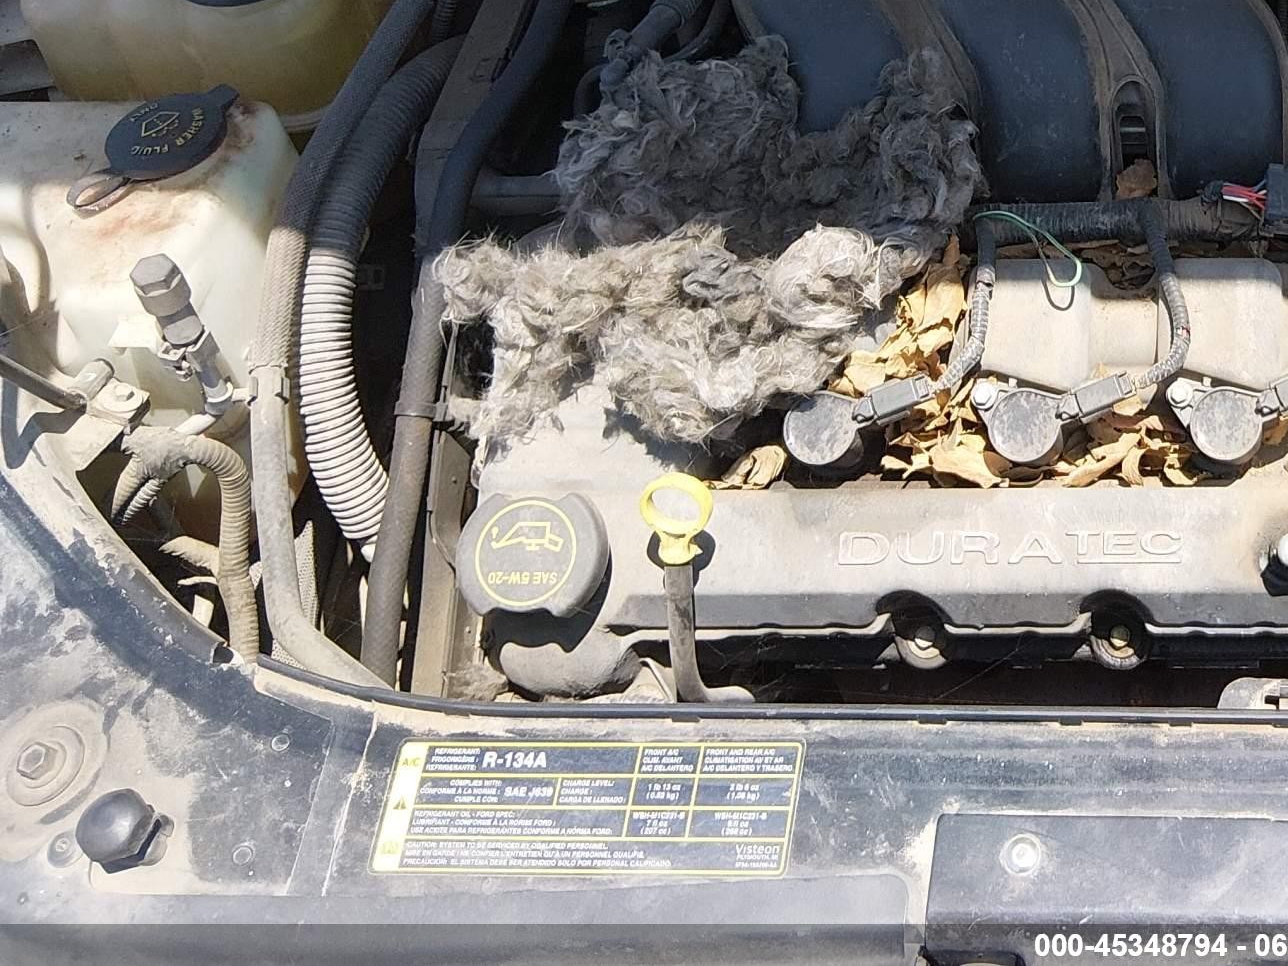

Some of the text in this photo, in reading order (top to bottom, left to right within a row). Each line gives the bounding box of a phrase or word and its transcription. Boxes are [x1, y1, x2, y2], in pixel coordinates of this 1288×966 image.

[130, 103, 159, 123] ONLY
[175, 107, 204, 146] WASHER
[838, 530, 1184, 565] DURATEC
[487, 571, 557, 585] SAE 5W-20
[482, 751, 547, 768] R-134A
[504, 787, 554, 797] SAE J639
[735, 844, 780, 854] Visteon
